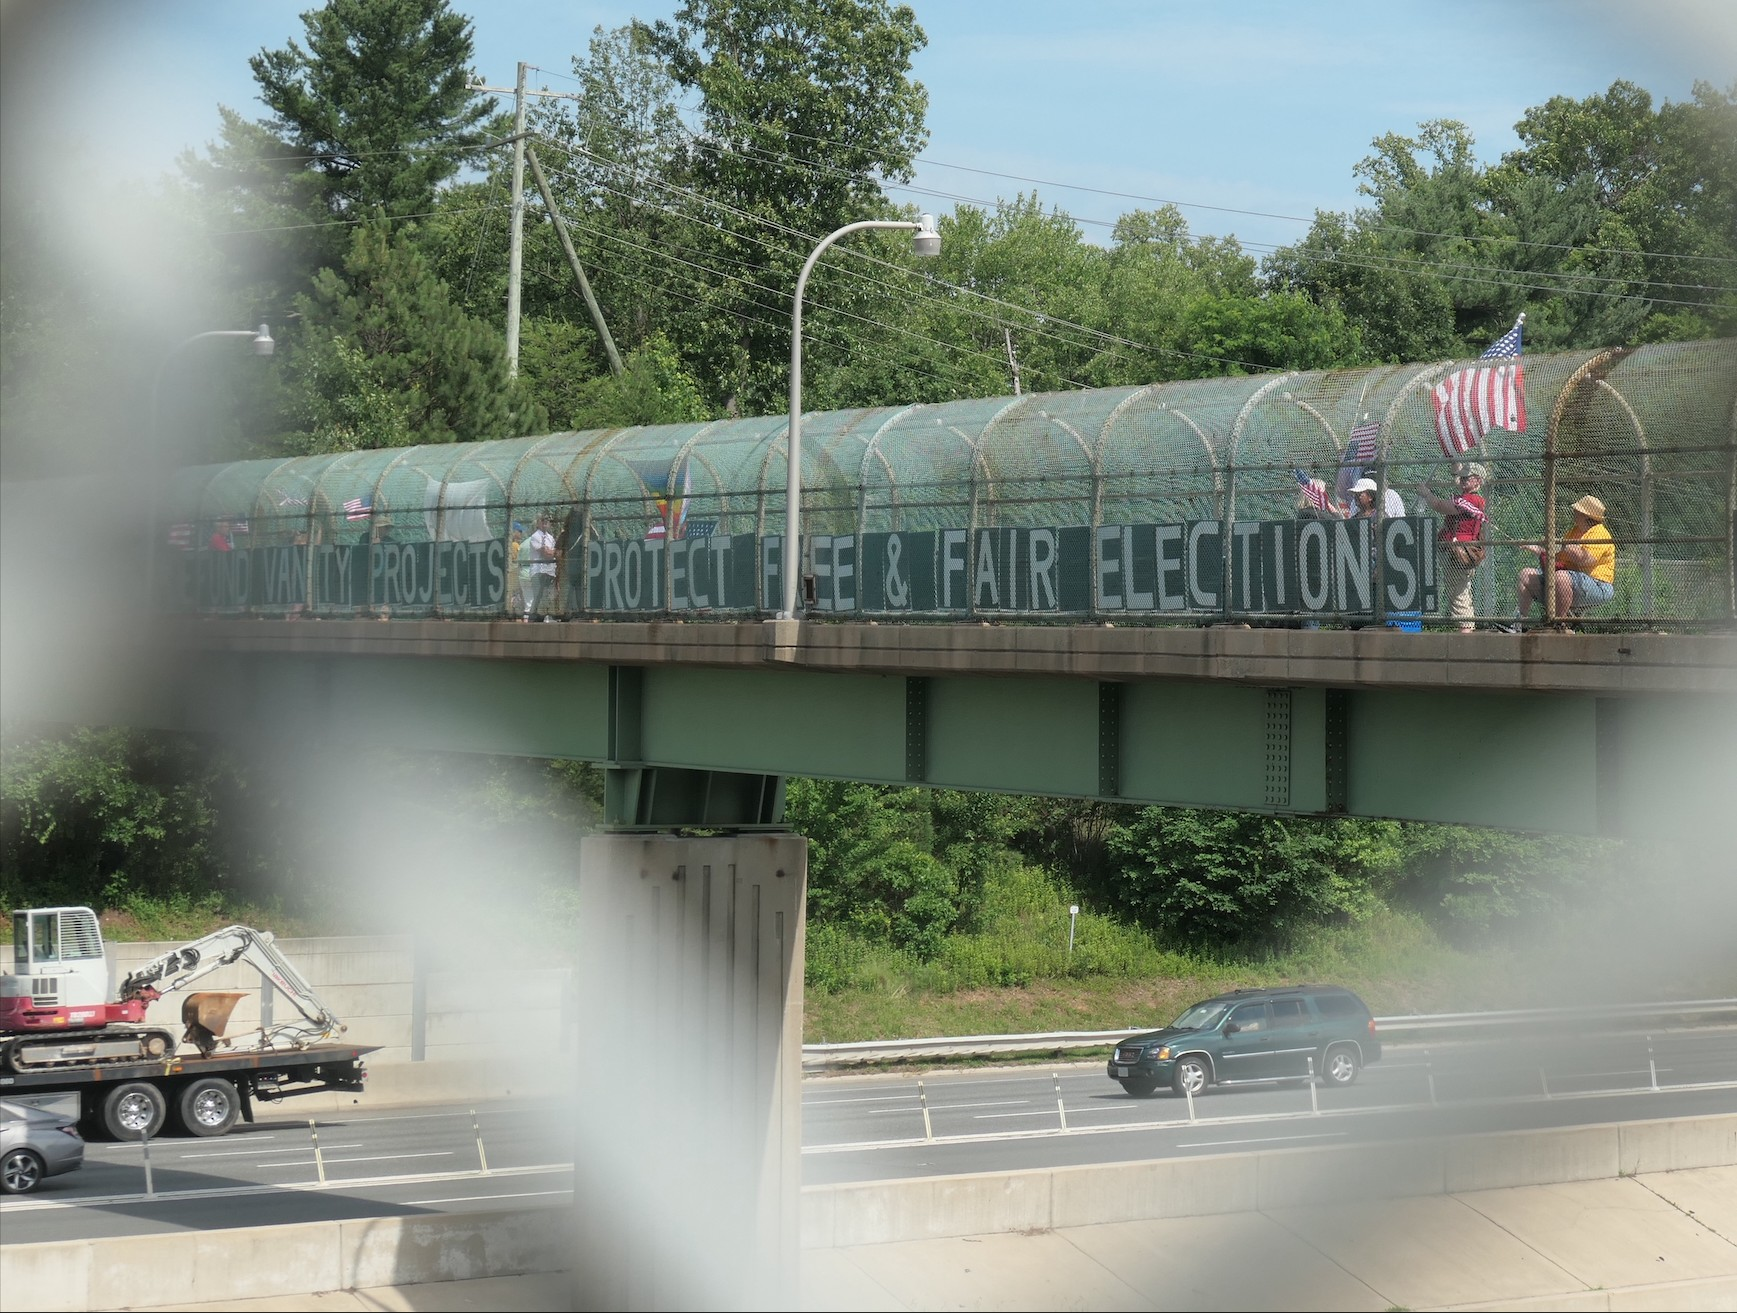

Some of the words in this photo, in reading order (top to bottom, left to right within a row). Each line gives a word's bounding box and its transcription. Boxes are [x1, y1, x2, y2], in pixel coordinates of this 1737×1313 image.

[371, 540, 504, 604] PROJECTS
[587, 536, 730, 609] PROTECT
[763, 534, 855, 611] FEE
[886, 532, 909, 608] &
[944, 529, 1056, 608] FAIR
[1097, 518, 1434, 611] ELECTIONS!
